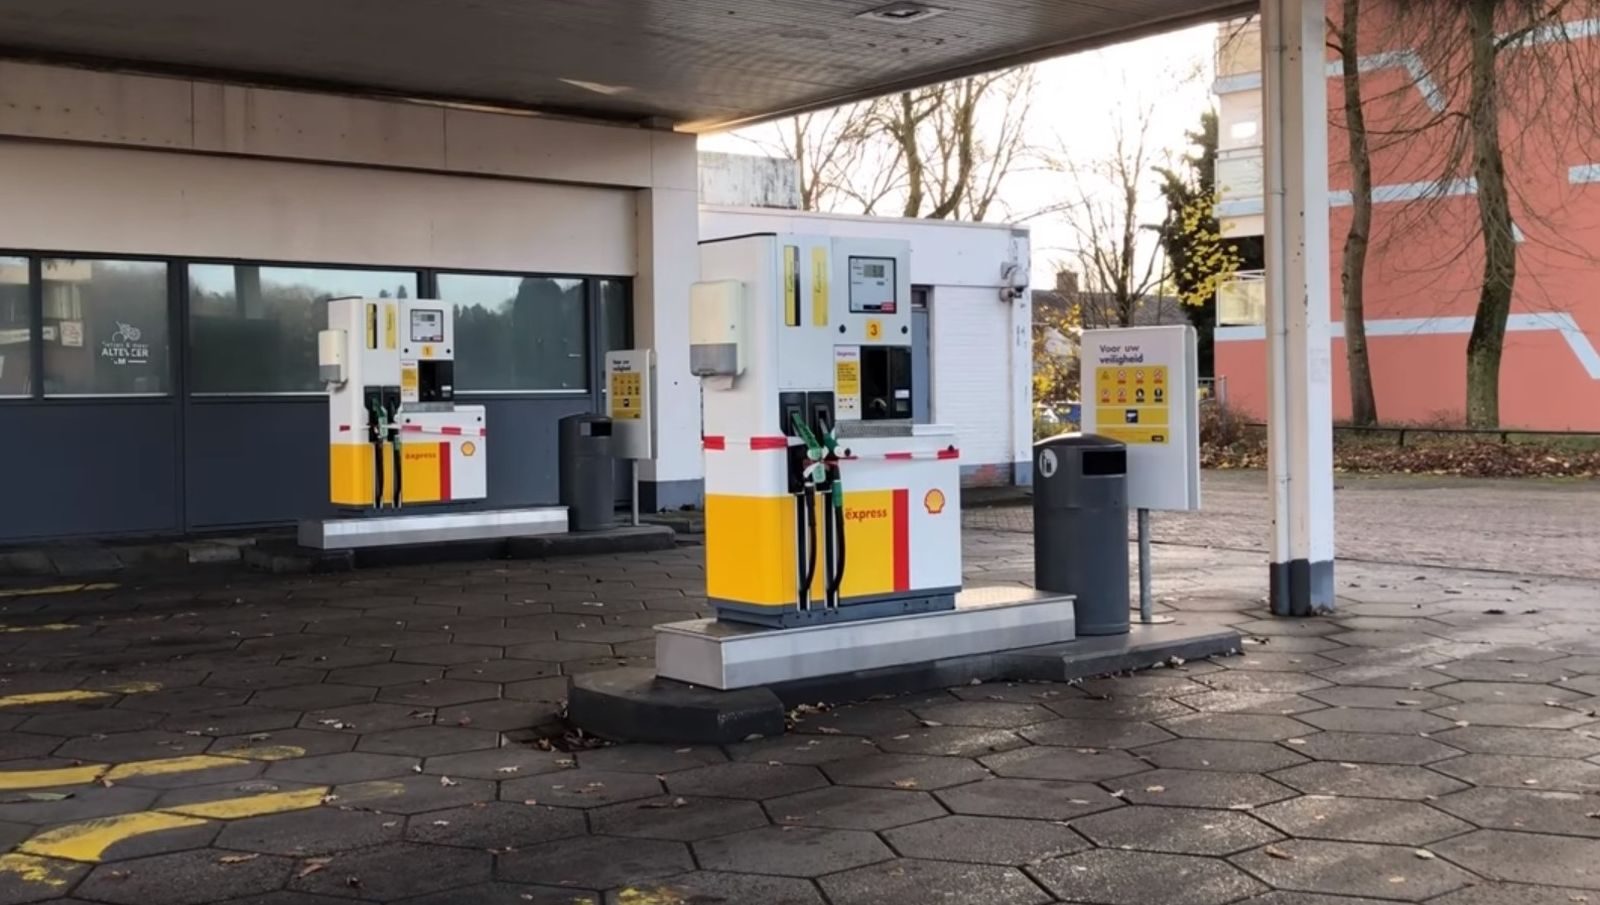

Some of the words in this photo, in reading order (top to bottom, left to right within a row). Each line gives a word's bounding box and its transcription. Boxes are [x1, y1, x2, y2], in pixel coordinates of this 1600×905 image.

[870, 324, 878, 336] 3
[1099, 344, 1121, 353] Voor
[1124, 345, 1140, 353] uw
[1099, 353, 1144, 366] veiligheid
[845, 509, 887, 522] express
